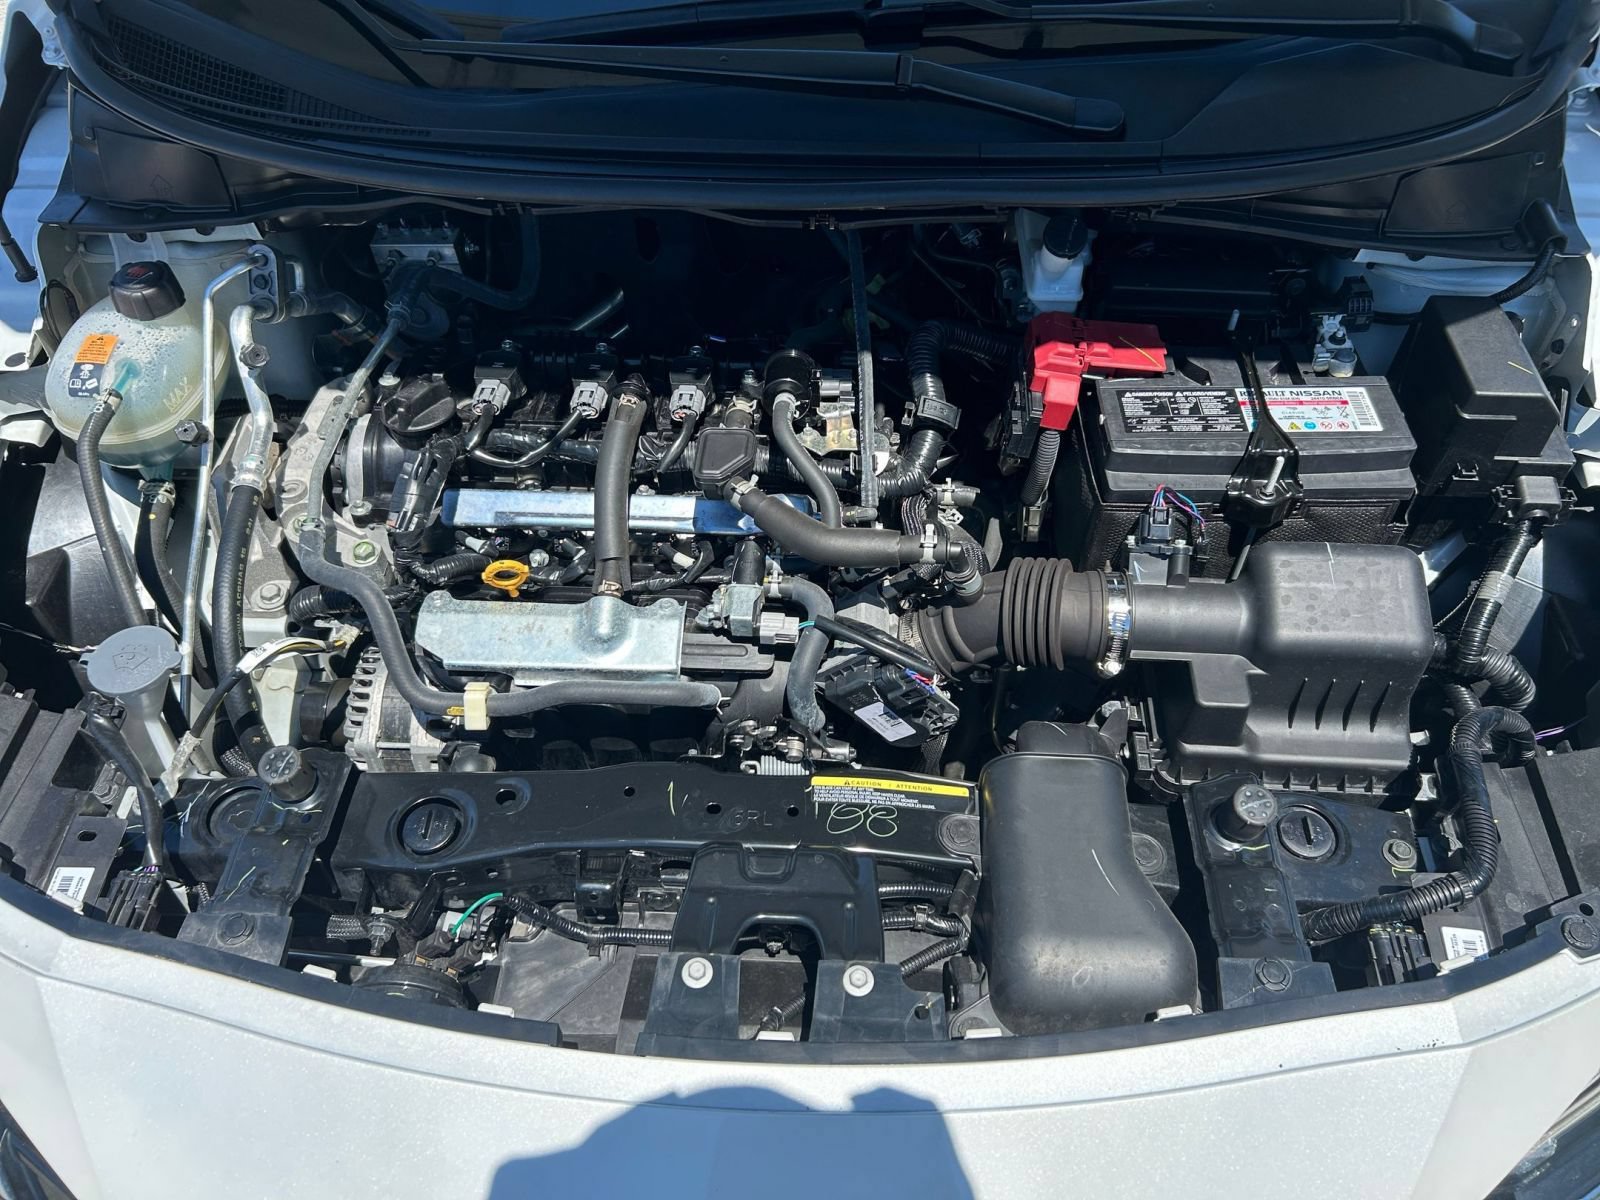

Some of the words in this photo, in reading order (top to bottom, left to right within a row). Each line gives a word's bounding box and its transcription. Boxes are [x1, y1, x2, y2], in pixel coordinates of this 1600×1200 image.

[163, 377, 193, 413] MAX
[851, 780, 882, 788] CAUTION
[896, 784, 933, 792] ATTENTION
